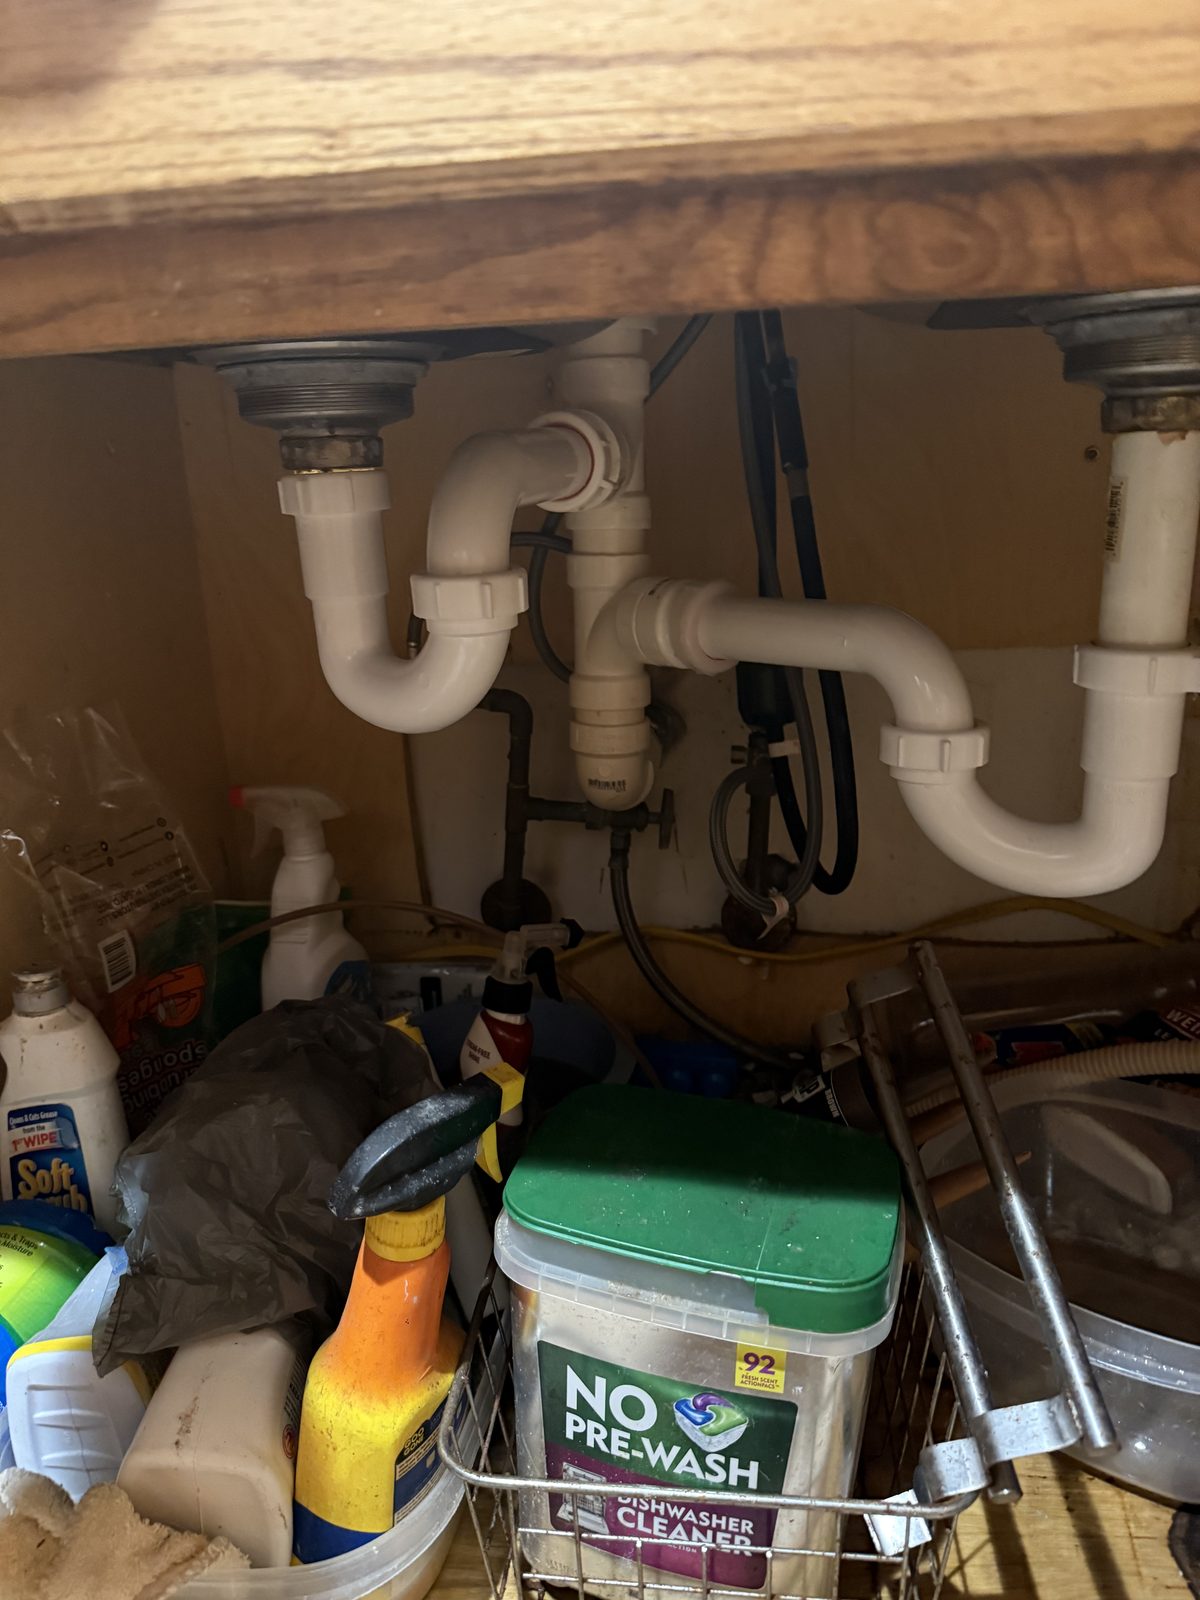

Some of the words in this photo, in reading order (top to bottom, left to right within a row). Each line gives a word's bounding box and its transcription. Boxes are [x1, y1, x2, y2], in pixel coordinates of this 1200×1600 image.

[825, 1088, 841, 1118] BROWN
[24, 1114, 28, 1122] &
[28, 1112, 40, 1121] Cuts
[40, 1111, 58, 1119] Grease
[22, 1126, 35, 1134] from
[23, 1131, 57, 1148] WIPE
[17, 1157, 74, 1198] Soft
[1, 1240, 33, 1257] Moisture
[11, 1233, 18, 1241] &
[19, 1235, 38, 1249] Traps
[743, 1352, 776, 1376] 92
[741, 1374, 759, 1382] FRESH
[760, 1376, 778, 1384] SCENT
[566, 1364, 658, 1432] NO
[403, 1437, 425, 1456] GONE
[404, 1427, 425, 1448] GOO
[565, 1412, 759, 1490] PRE-WASH
[616, 1507, 753, 1557] CLEANER
